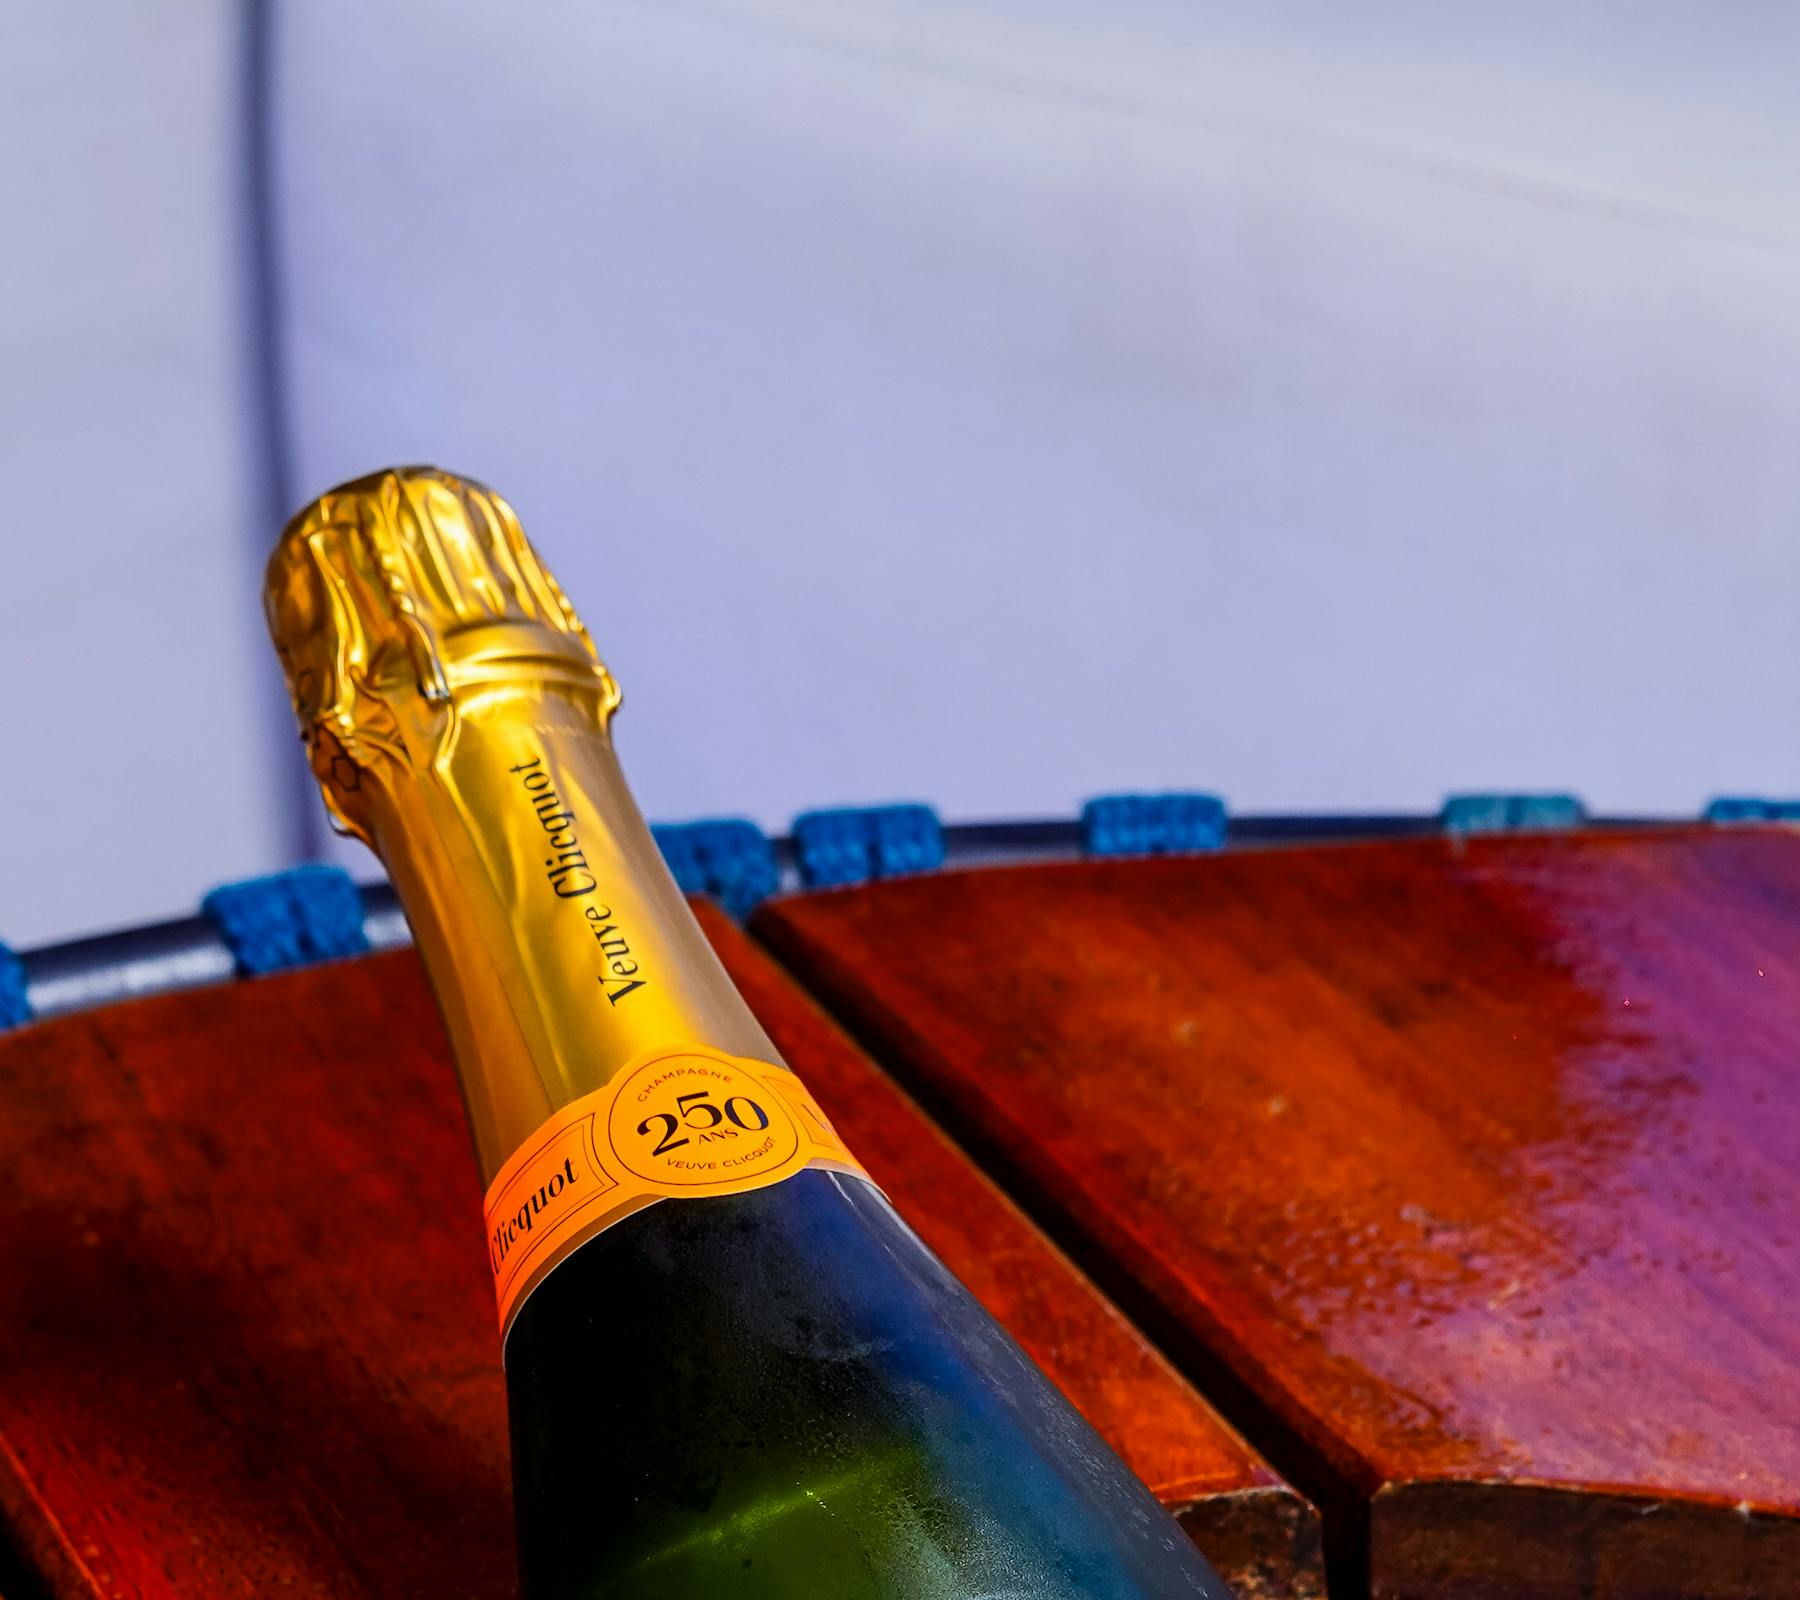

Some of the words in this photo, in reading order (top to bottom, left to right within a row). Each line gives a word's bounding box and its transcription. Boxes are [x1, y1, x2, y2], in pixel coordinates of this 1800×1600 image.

[510, 757, 597, 899] Clicquot
[585, 904, 646, 1007] Veuve
[637, 1066, 734, 1103] CHAMPAGNE
[637, 1091, 769, 1157] 250
[667, 1157, 717, 1170] VEUVE
[722, 1135, 776, 1168] CLICQUOT
[698, 1127, 739, 1145] ANS
[491, 1157, 580, 1275] Clicquot
